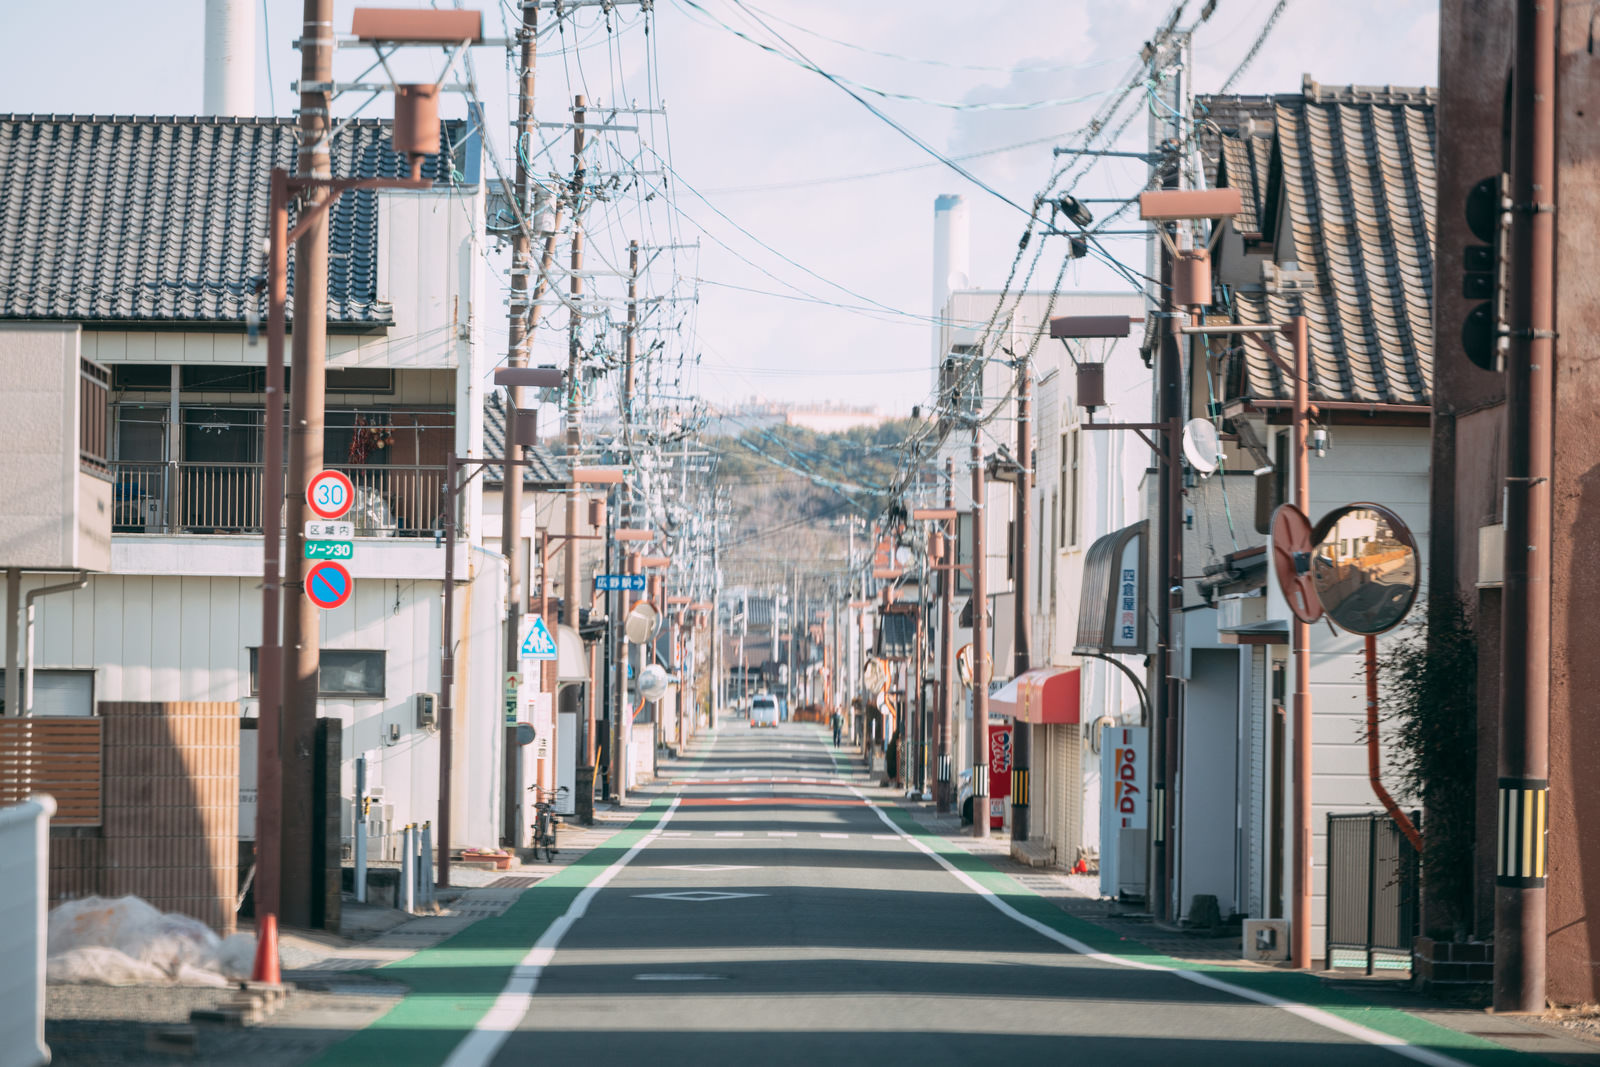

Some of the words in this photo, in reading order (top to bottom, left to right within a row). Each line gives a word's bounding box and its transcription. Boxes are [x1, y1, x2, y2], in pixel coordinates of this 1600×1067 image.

[318, 484, 343, 505] 30
[310, 524, 349, 536] 区域内
[308, 543, 351, 556] ゾーン30
[597, 576, 632, 588] 広野駅
[1120, 748, 1140, 814] DyDo
